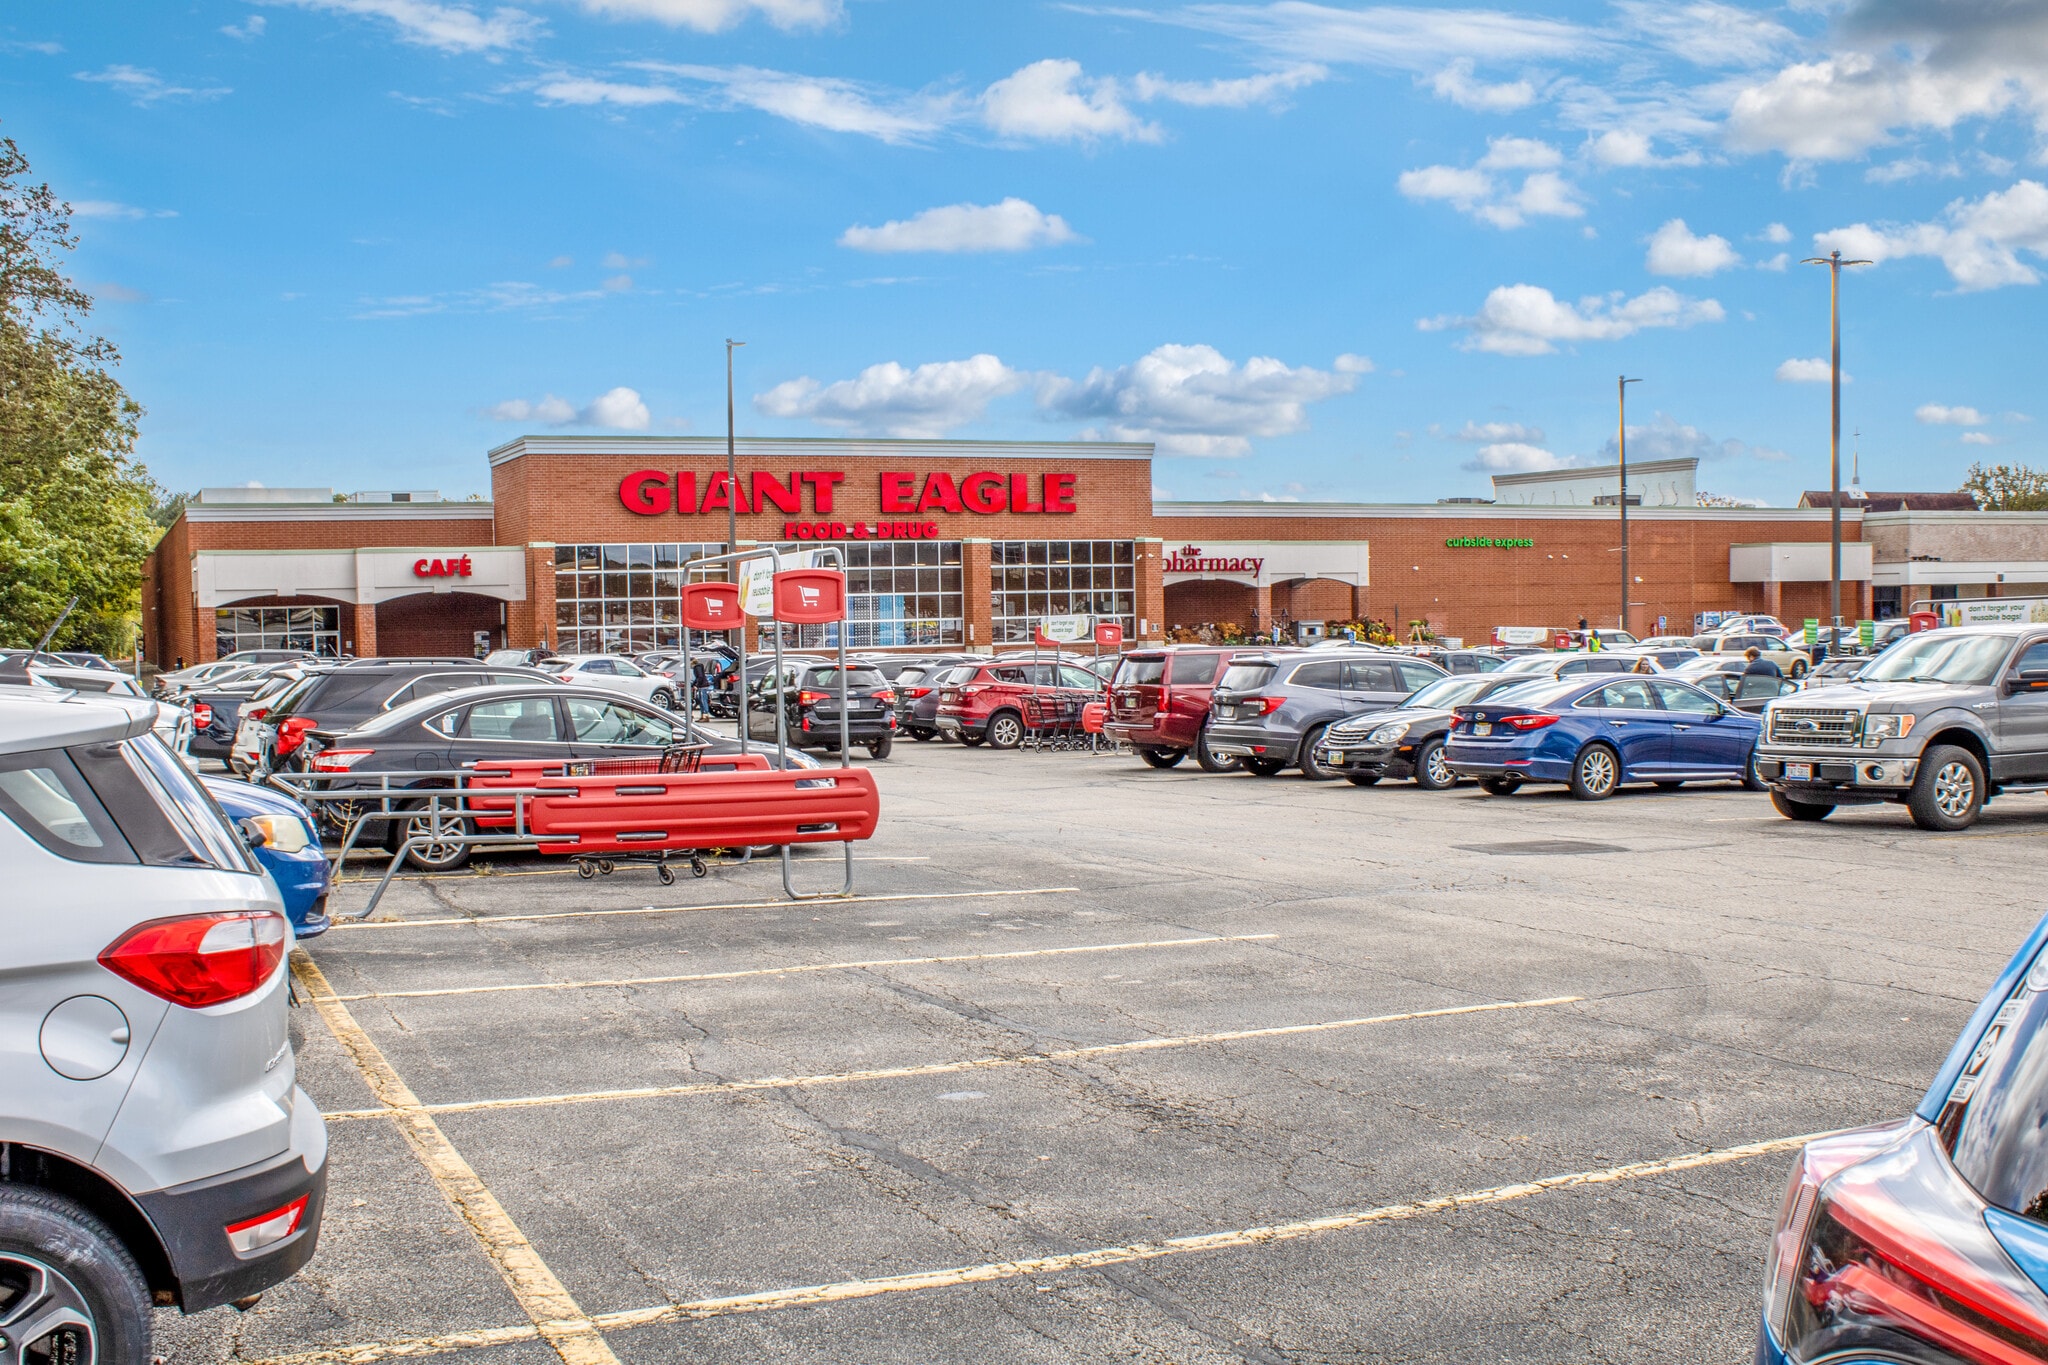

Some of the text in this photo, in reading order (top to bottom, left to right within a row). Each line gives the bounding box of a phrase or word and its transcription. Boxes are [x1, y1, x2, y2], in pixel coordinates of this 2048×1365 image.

[618, 469, 1078, 515] GIANT EAGLE
[785, 521, 939, 540] FOOD & DRUG
[1181, 544, 1202, 556] the
[1446, 535, 1534, 550] curbside express
[413, 553, 472, 578] CAFÉ
[1987, 605, 2008, 613] forget
[1970, 613, 2022, 622] reusable bags!
